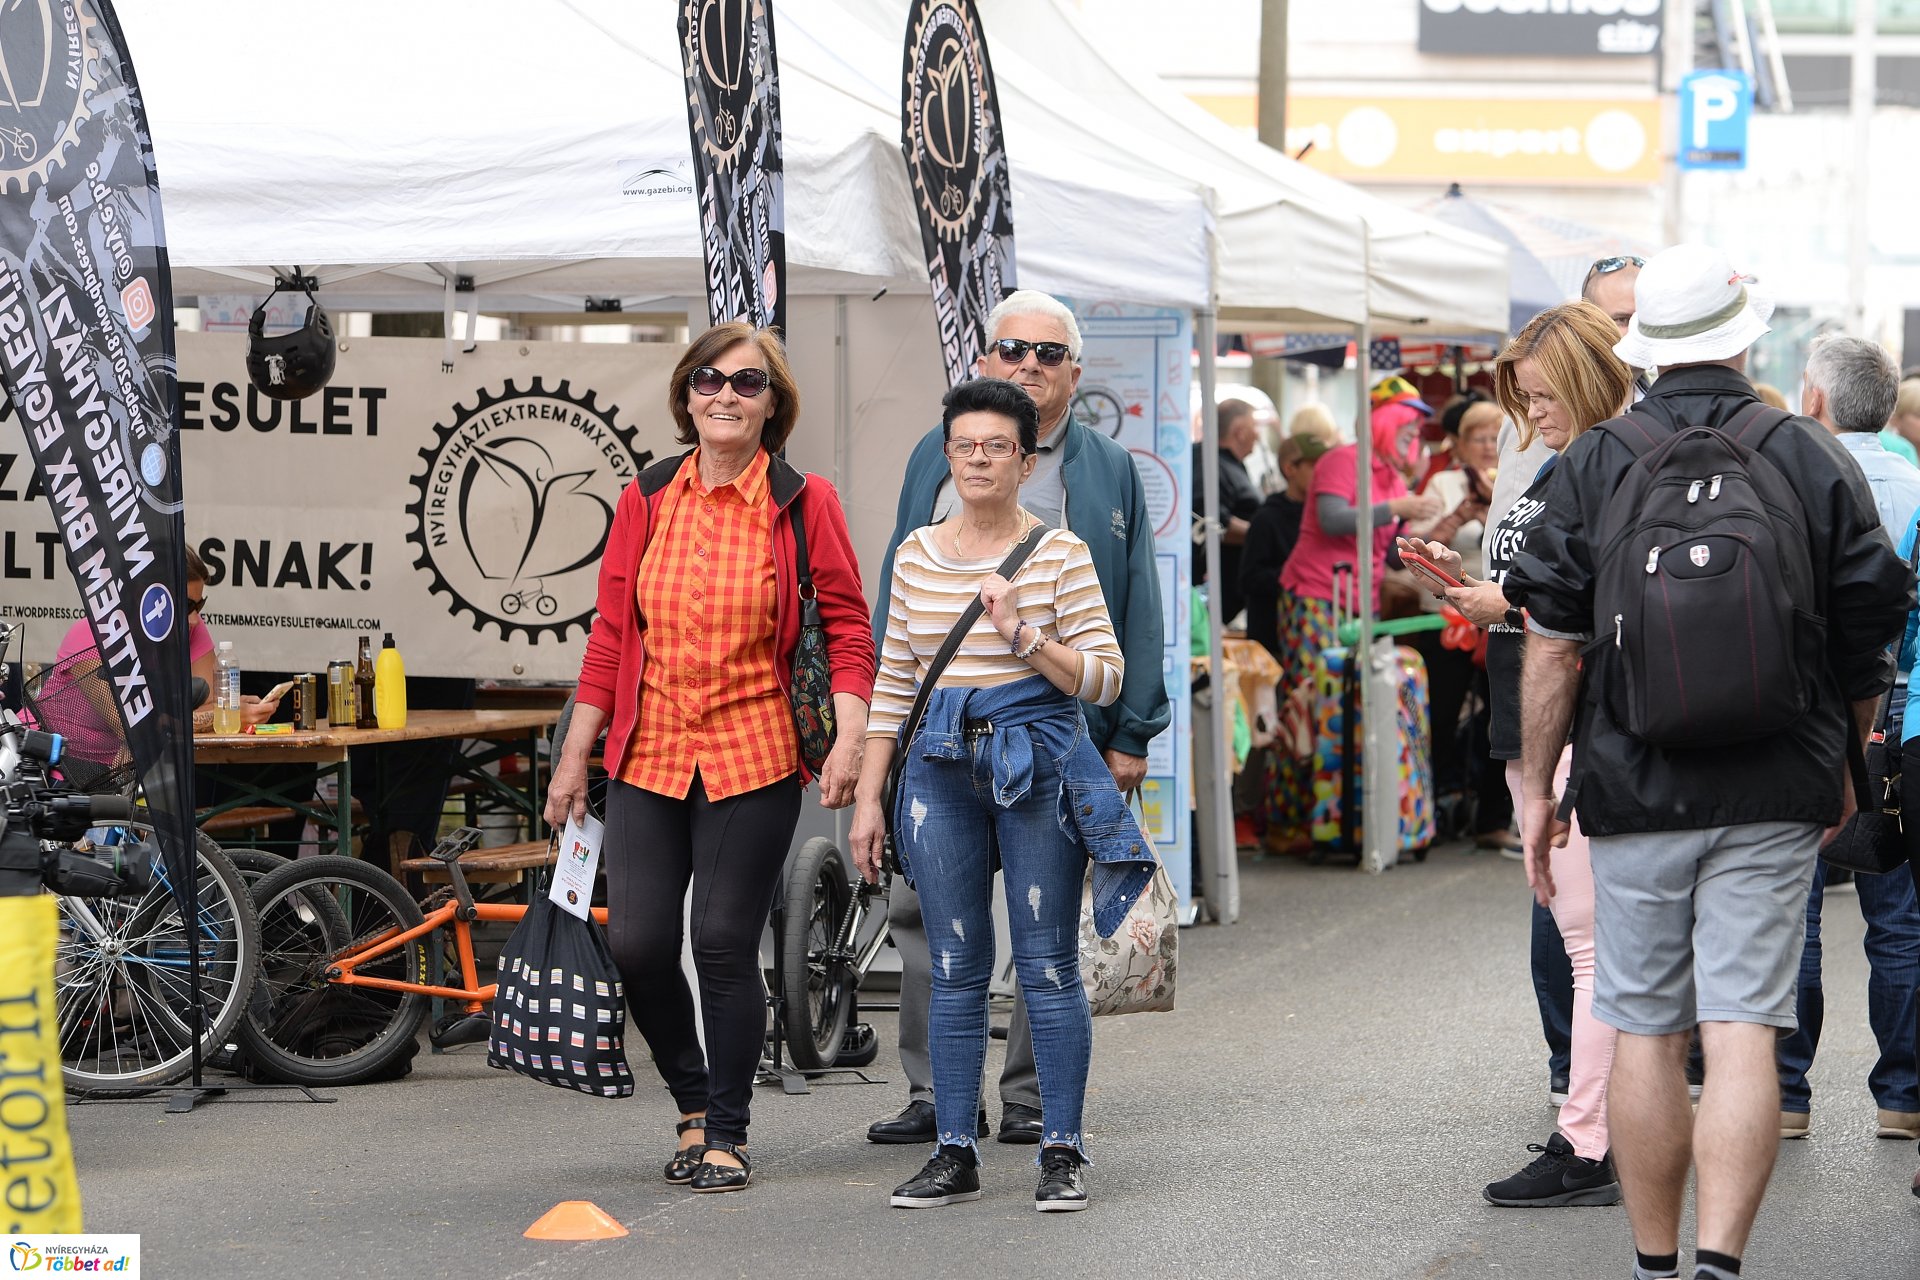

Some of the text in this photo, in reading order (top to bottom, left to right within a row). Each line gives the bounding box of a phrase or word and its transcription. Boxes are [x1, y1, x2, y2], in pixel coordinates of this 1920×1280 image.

[1693, 86, 1738, 149] P
[623, 185, 692, 196] www.gazebi.org
[491, 404, 567, 427] EXTREM
[570, 413, 606, 446] BMX
[0, 606, 86, 620] ET.WORDPRESS.CO
